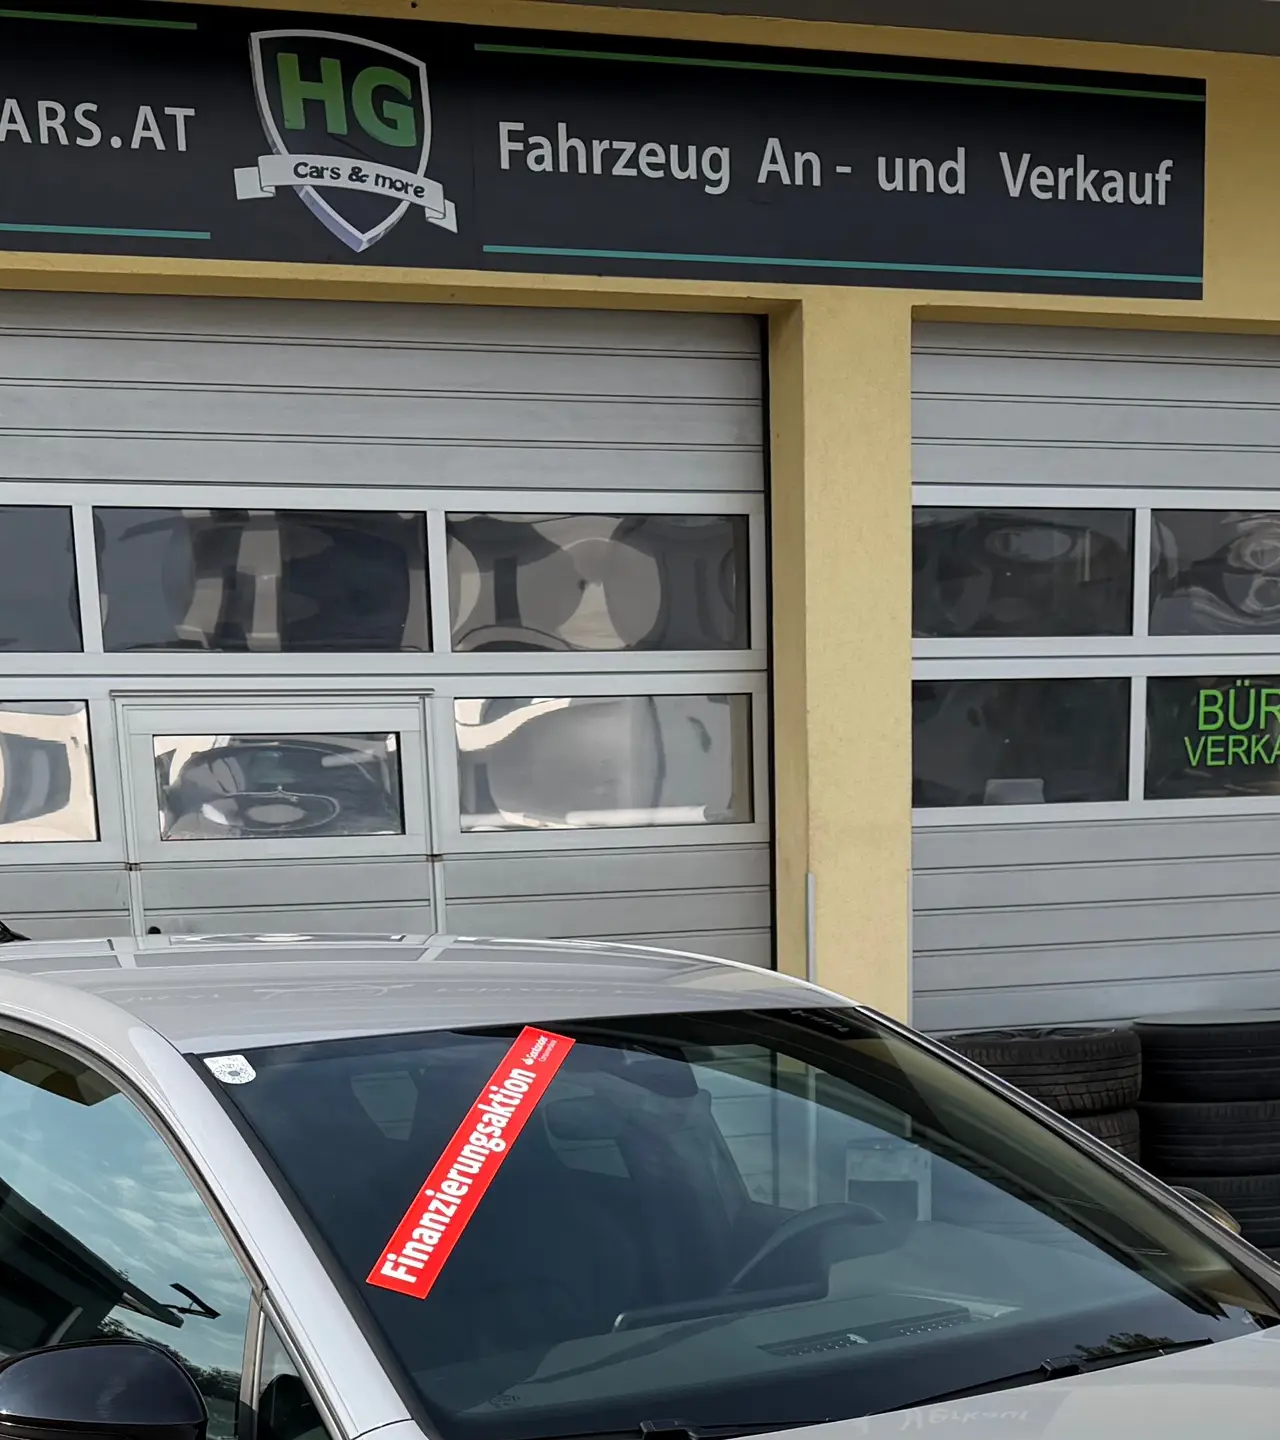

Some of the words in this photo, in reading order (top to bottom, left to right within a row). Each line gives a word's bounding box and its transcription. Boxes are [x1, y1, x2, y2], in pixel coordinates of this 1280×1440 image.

[276, 52, 417, 148] HG
[292, 161, 341, 180] Cars
[347, 165, 370, 184] &
[374, 172, 426, 199] more
[498, 120, 731, 195] Fahrzeug
[876, 145, 966, 195] und
[999, 149, 1174, 206] Verkauf
[379, 1067, 537, 1284] Finanzierungsaktion
